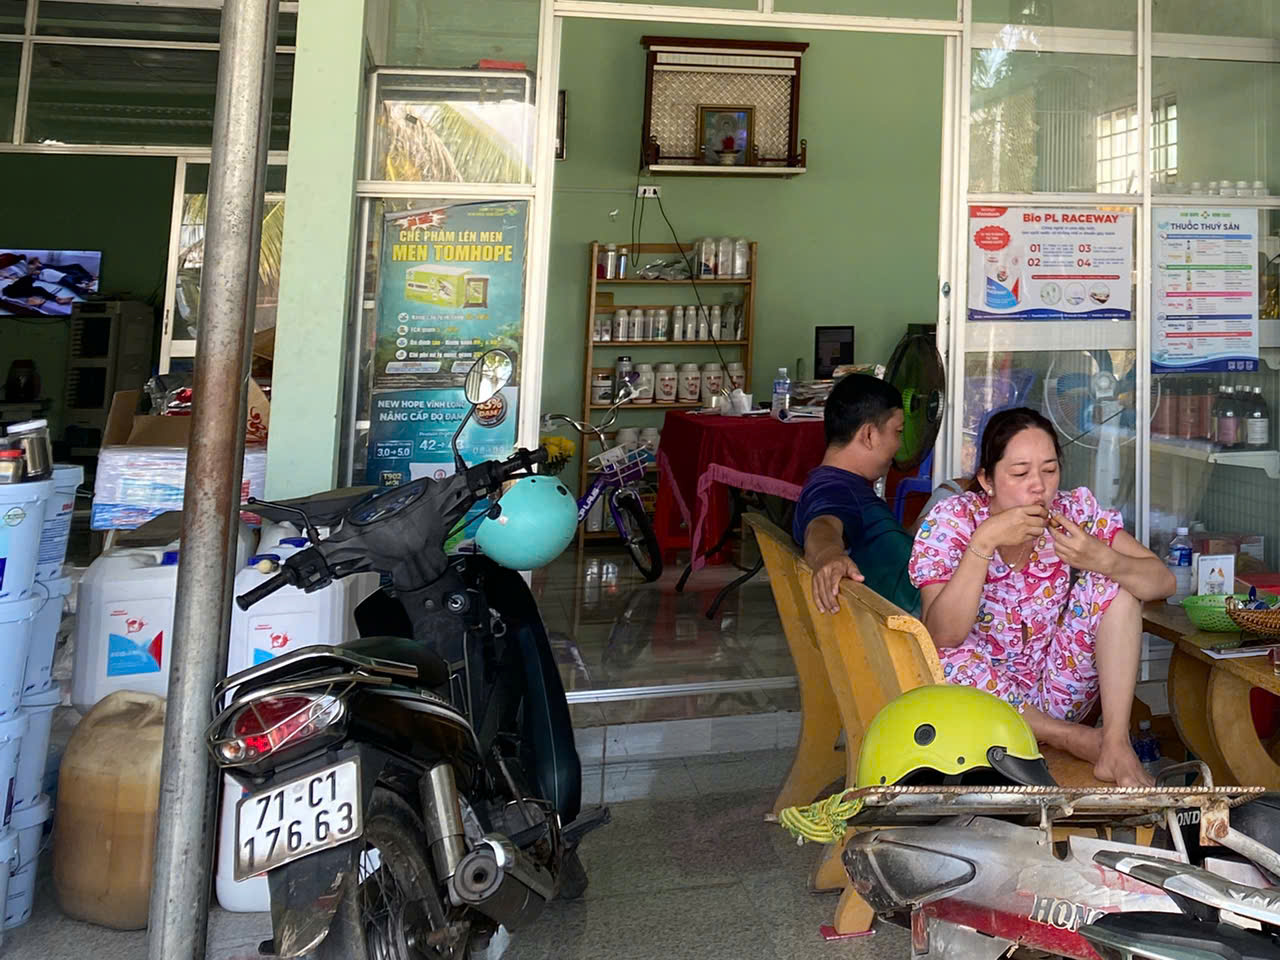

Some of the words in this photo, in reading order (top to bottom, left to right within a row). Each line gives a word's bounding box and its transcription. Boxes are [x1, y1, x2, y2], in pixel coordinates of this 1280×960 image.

[1023, 213, 1041, 223] Bio
[1044, 213, 1059, 222] PL
[1062, 214, 1119, 223] RACEWAY
[1171, 219, 1199, 230] THUỐC
[480, 231, 503, 242] MEN
[392, 244, 428, 261] MEN
[433, 244, 513, 261] TOMHOPE
[1030, 244, 1040, 253] 01
[1078, 244, 1092, 253] 03
[1028, 258, 1041, 267] 02
[1077, 259, 1091, 267] 04
[378, 400, 400, 408] NEW
[401, 400, 424, 408] HOPE
[380, 411, 408, 421] NÂNG
[420, 439, 436, 450] 42
[256, 770, 337, 830] 71-C1
[244, 801, 353, 868] 176.63
